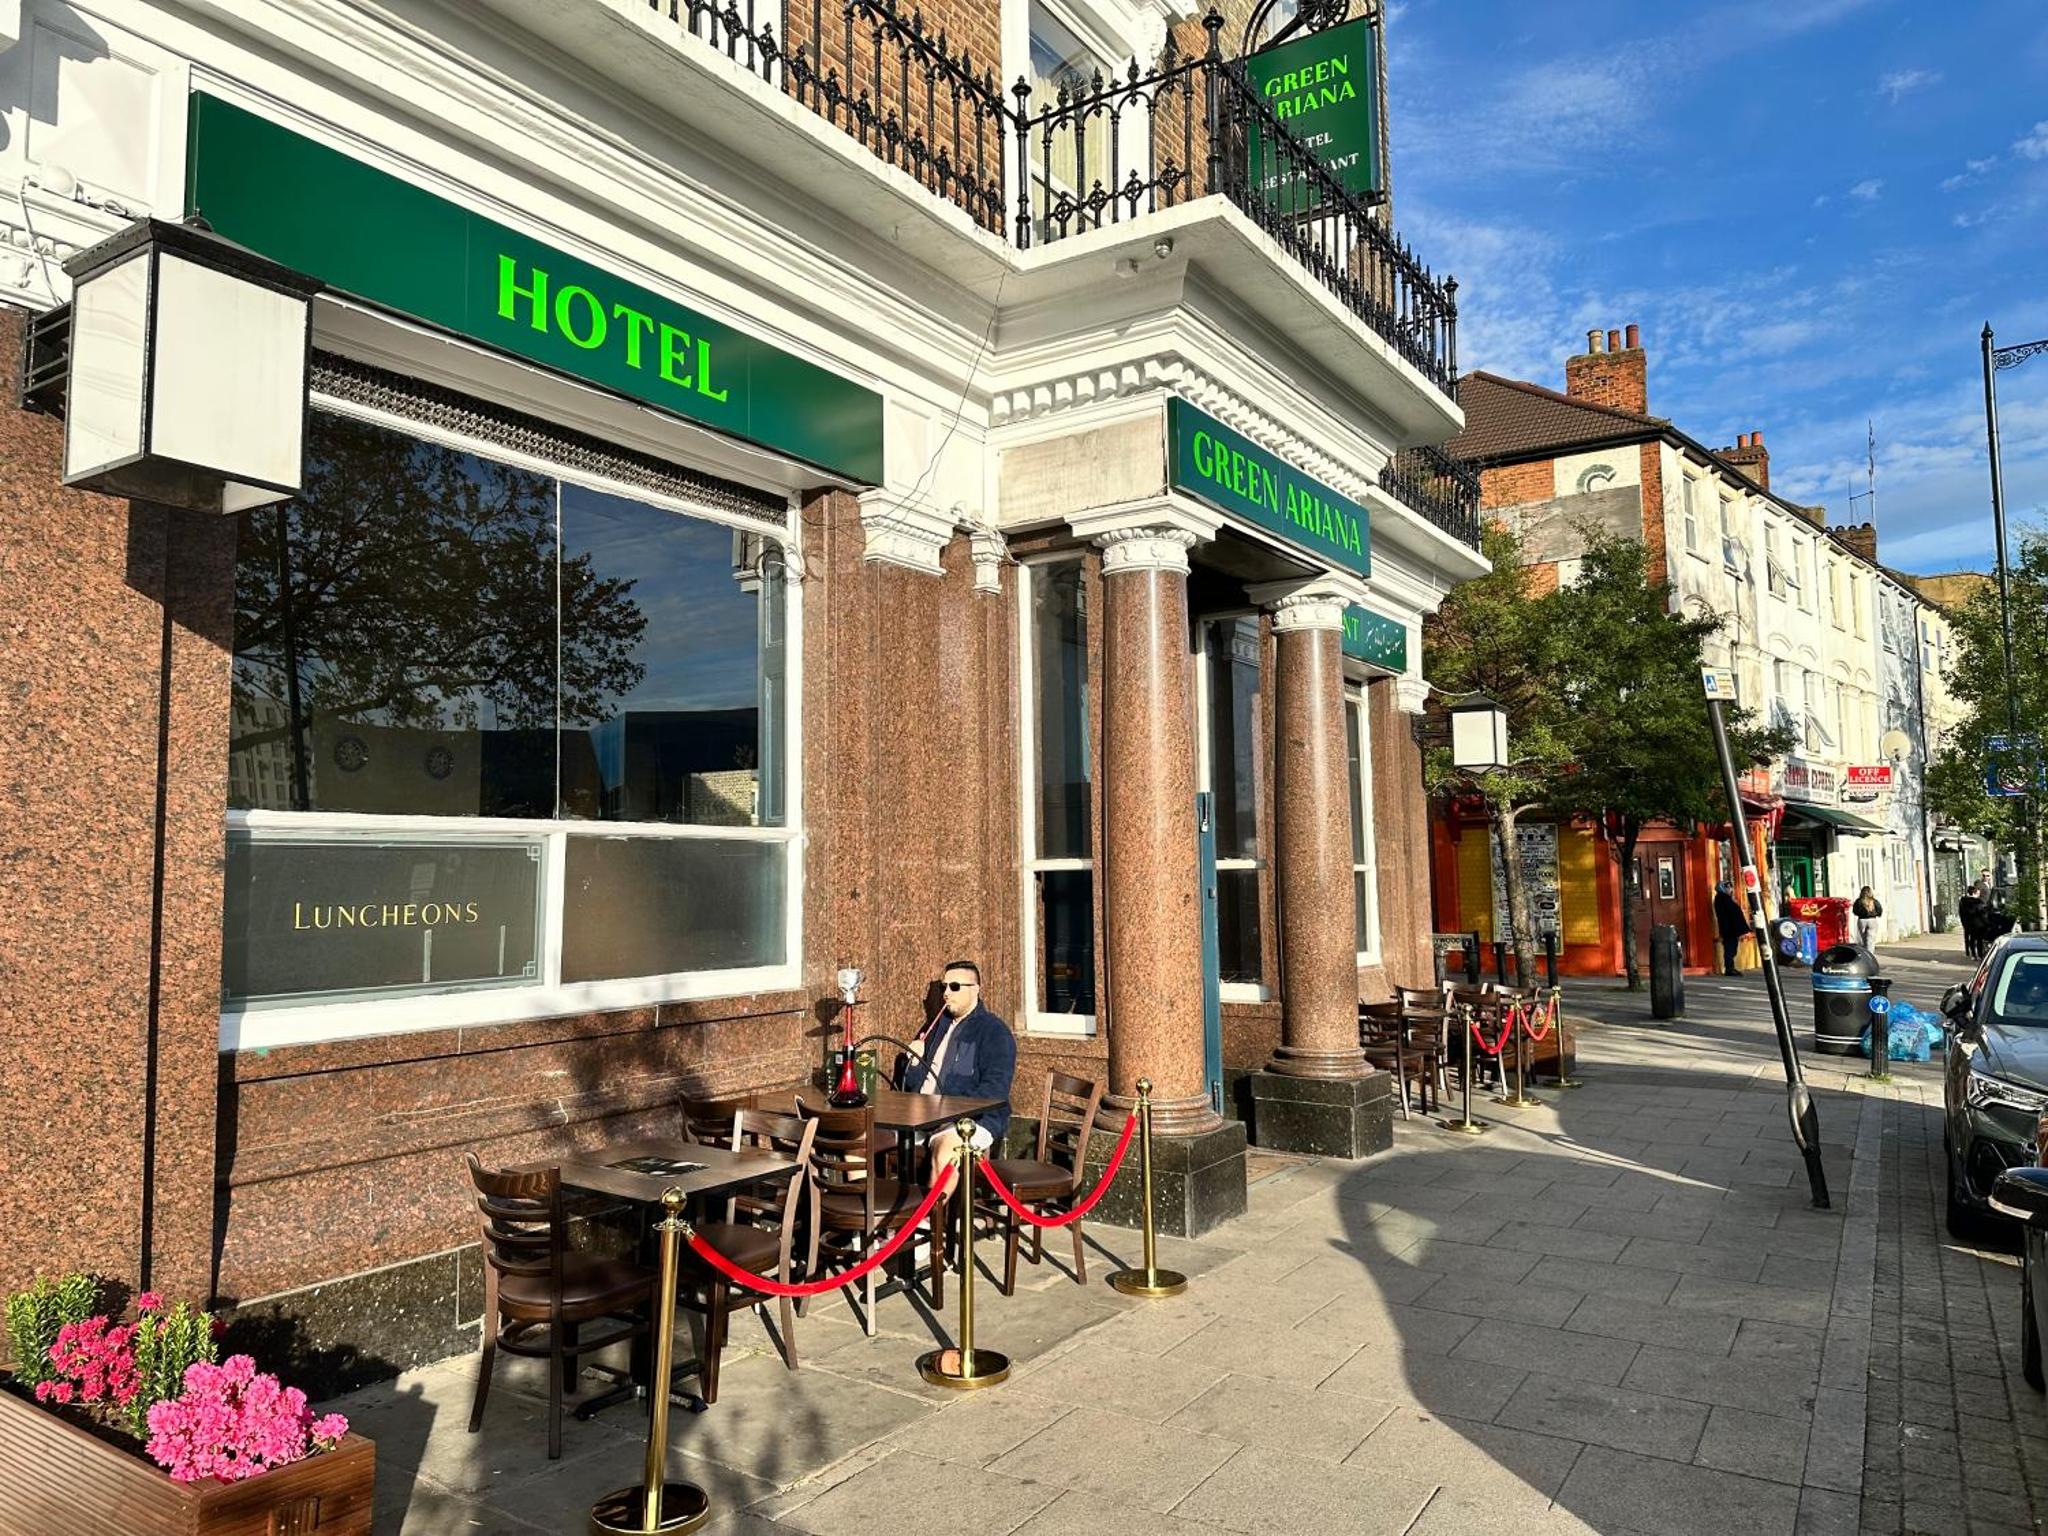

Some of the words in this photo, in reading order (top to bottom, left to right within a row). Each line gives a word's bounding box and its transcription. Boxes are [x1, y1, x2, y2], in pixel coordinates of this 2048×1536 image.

[1265, 54, 1348, 97] GREEN
[1276, 80, 1357, 121] RIANA
[1259, 153, 1360, 190] ESTAANT
[497, 254, 729, 403] HOTEL
[1193, 431, 1279, 515] GREEN
[1285, 484, 1363, 557] ARIANA
[1849, 775, 1890, 783] LICENCE
[1858, 767, 1880, 776] OFF
[293, 901, 480, 930] LUNCHEONS
